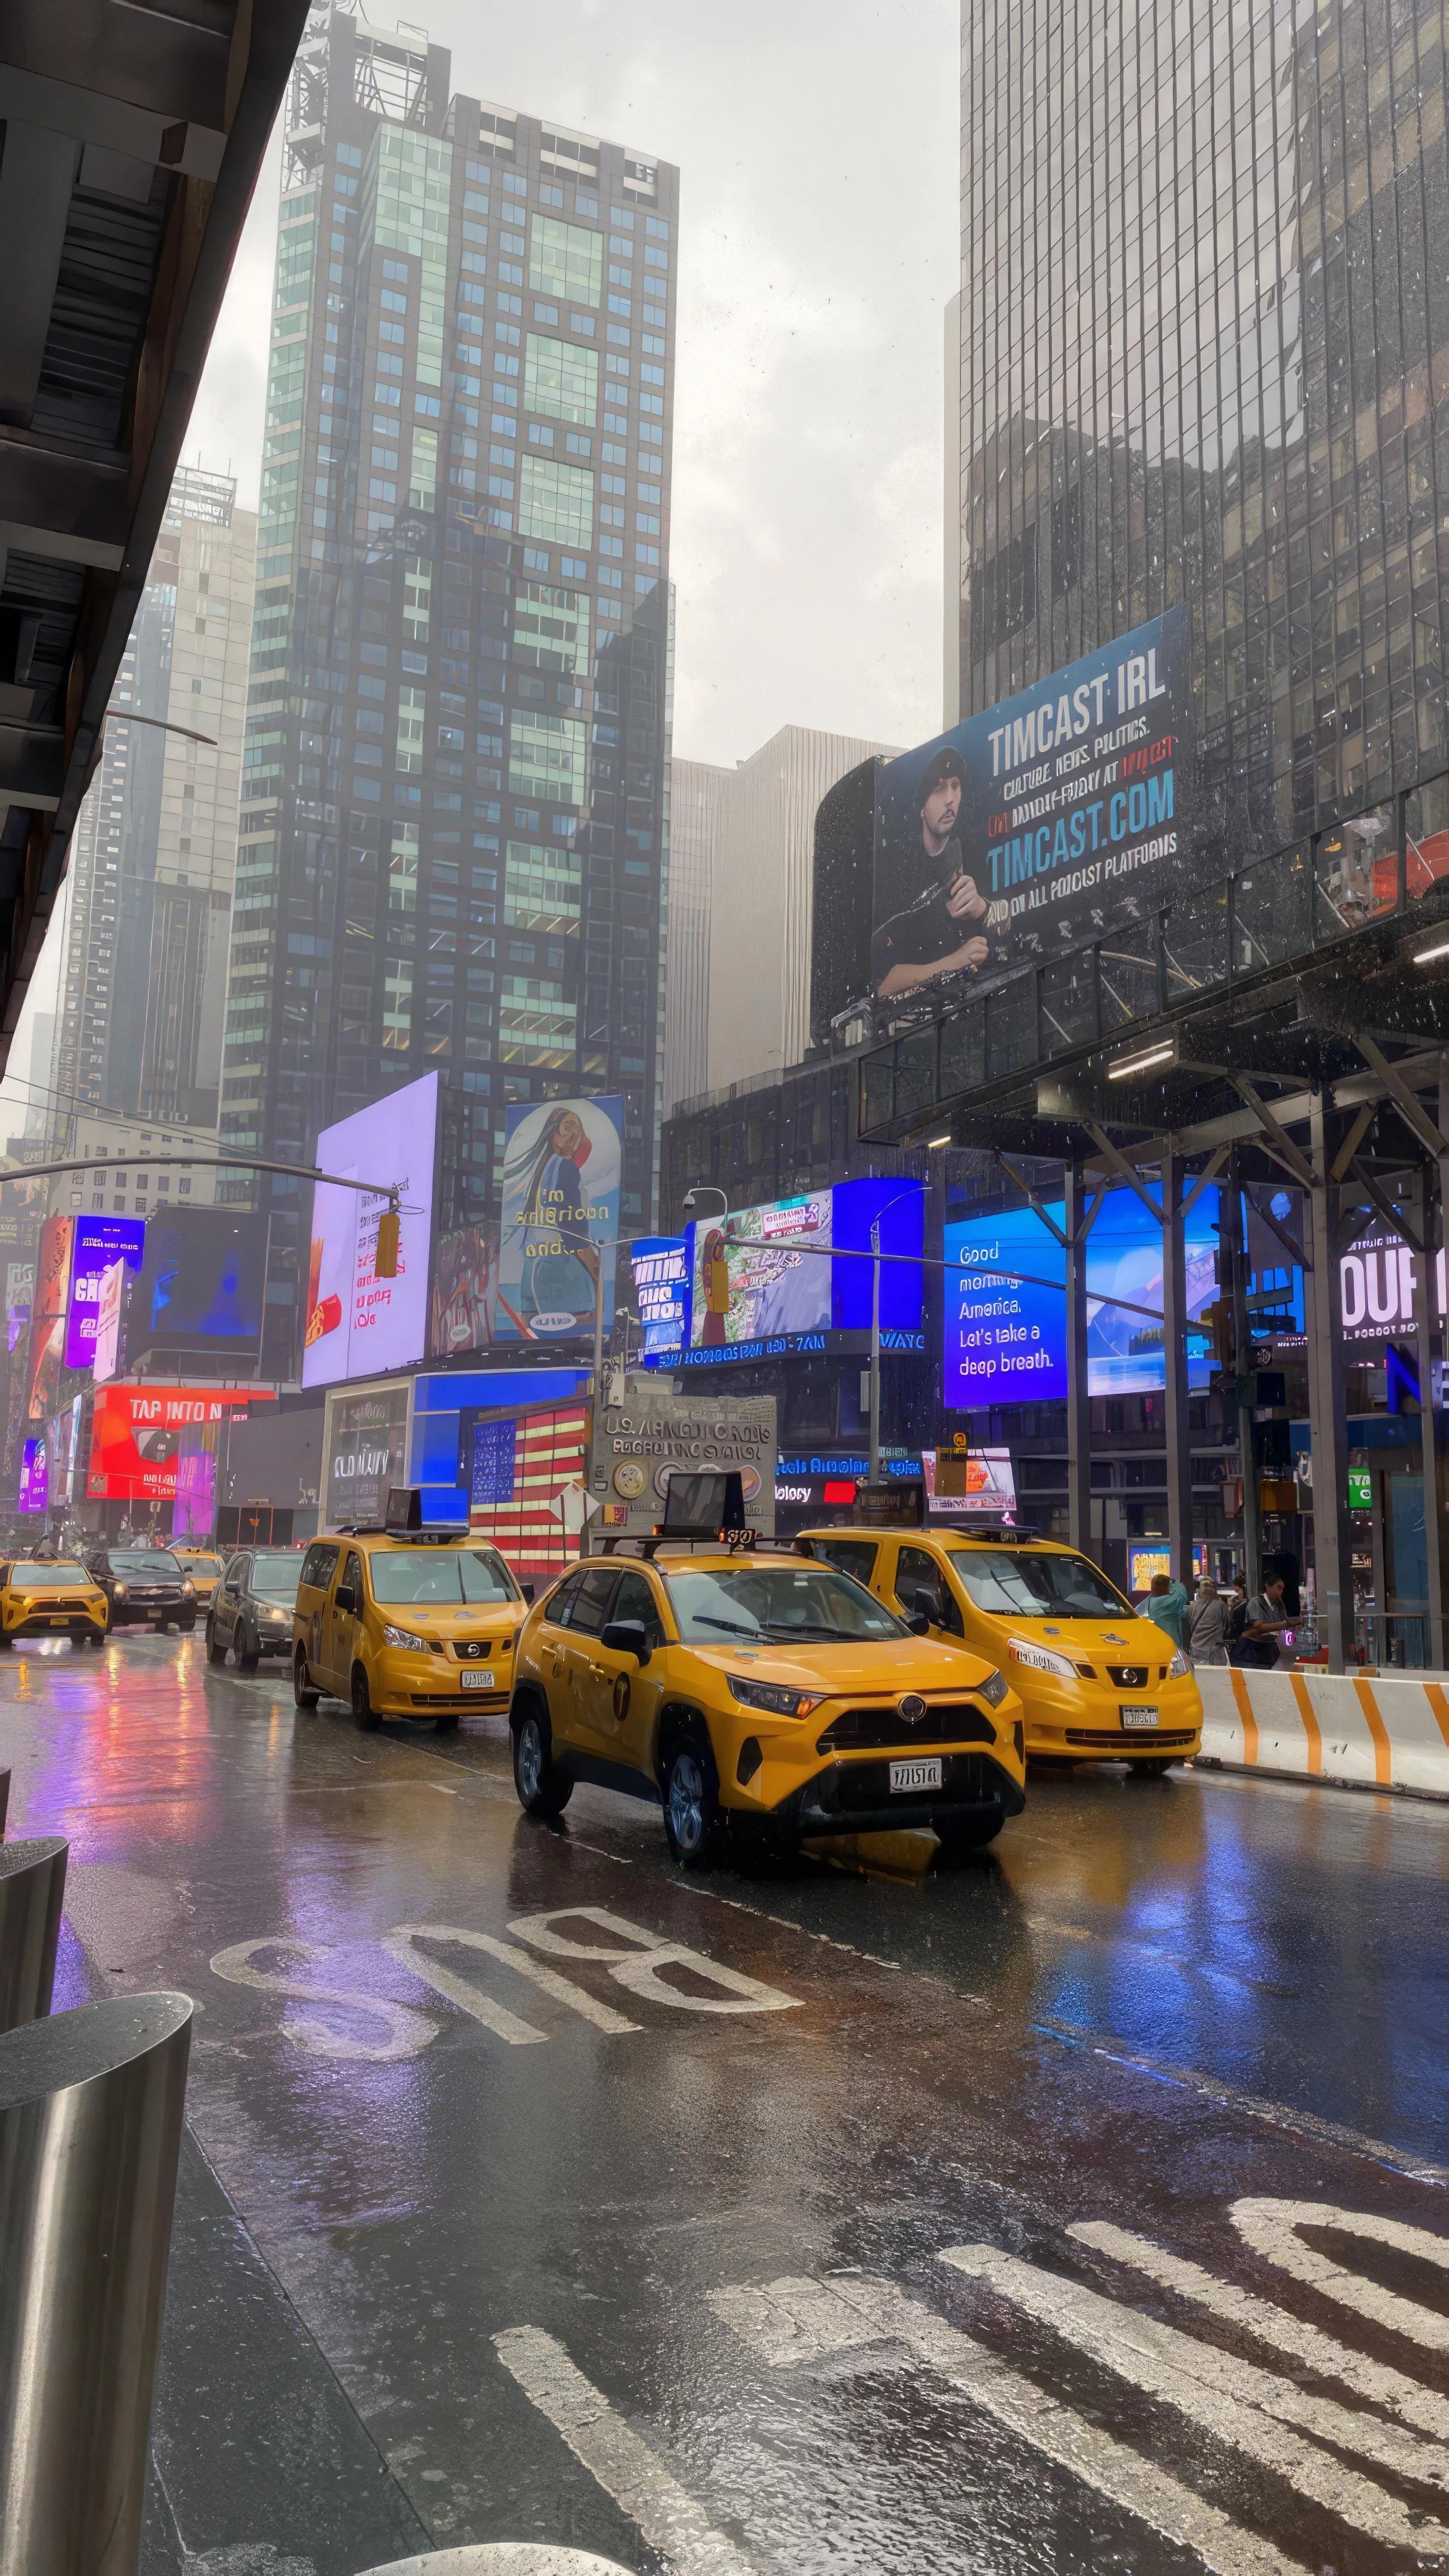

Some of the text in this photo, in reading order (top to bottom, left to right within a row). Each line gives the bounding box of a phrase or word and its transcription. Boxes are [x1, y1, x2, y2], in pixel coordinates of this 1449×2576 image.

[988, 647, 1166, 777] TIMCAST IRL
[987, 769, 1174, 892] TIMCAST.COM
[1028, 885, 1048, 911] ALL
[959, 1241, 999, 1265] Good
[1030, 1325, 1040, 1340] a
[959, 1347, 1054, 1378] deep breath.
[130, 1399, 161, 1419] TAP
[167, 1401, 205, 1421] INTO
[210, 1906, 806, 2061] BUS
